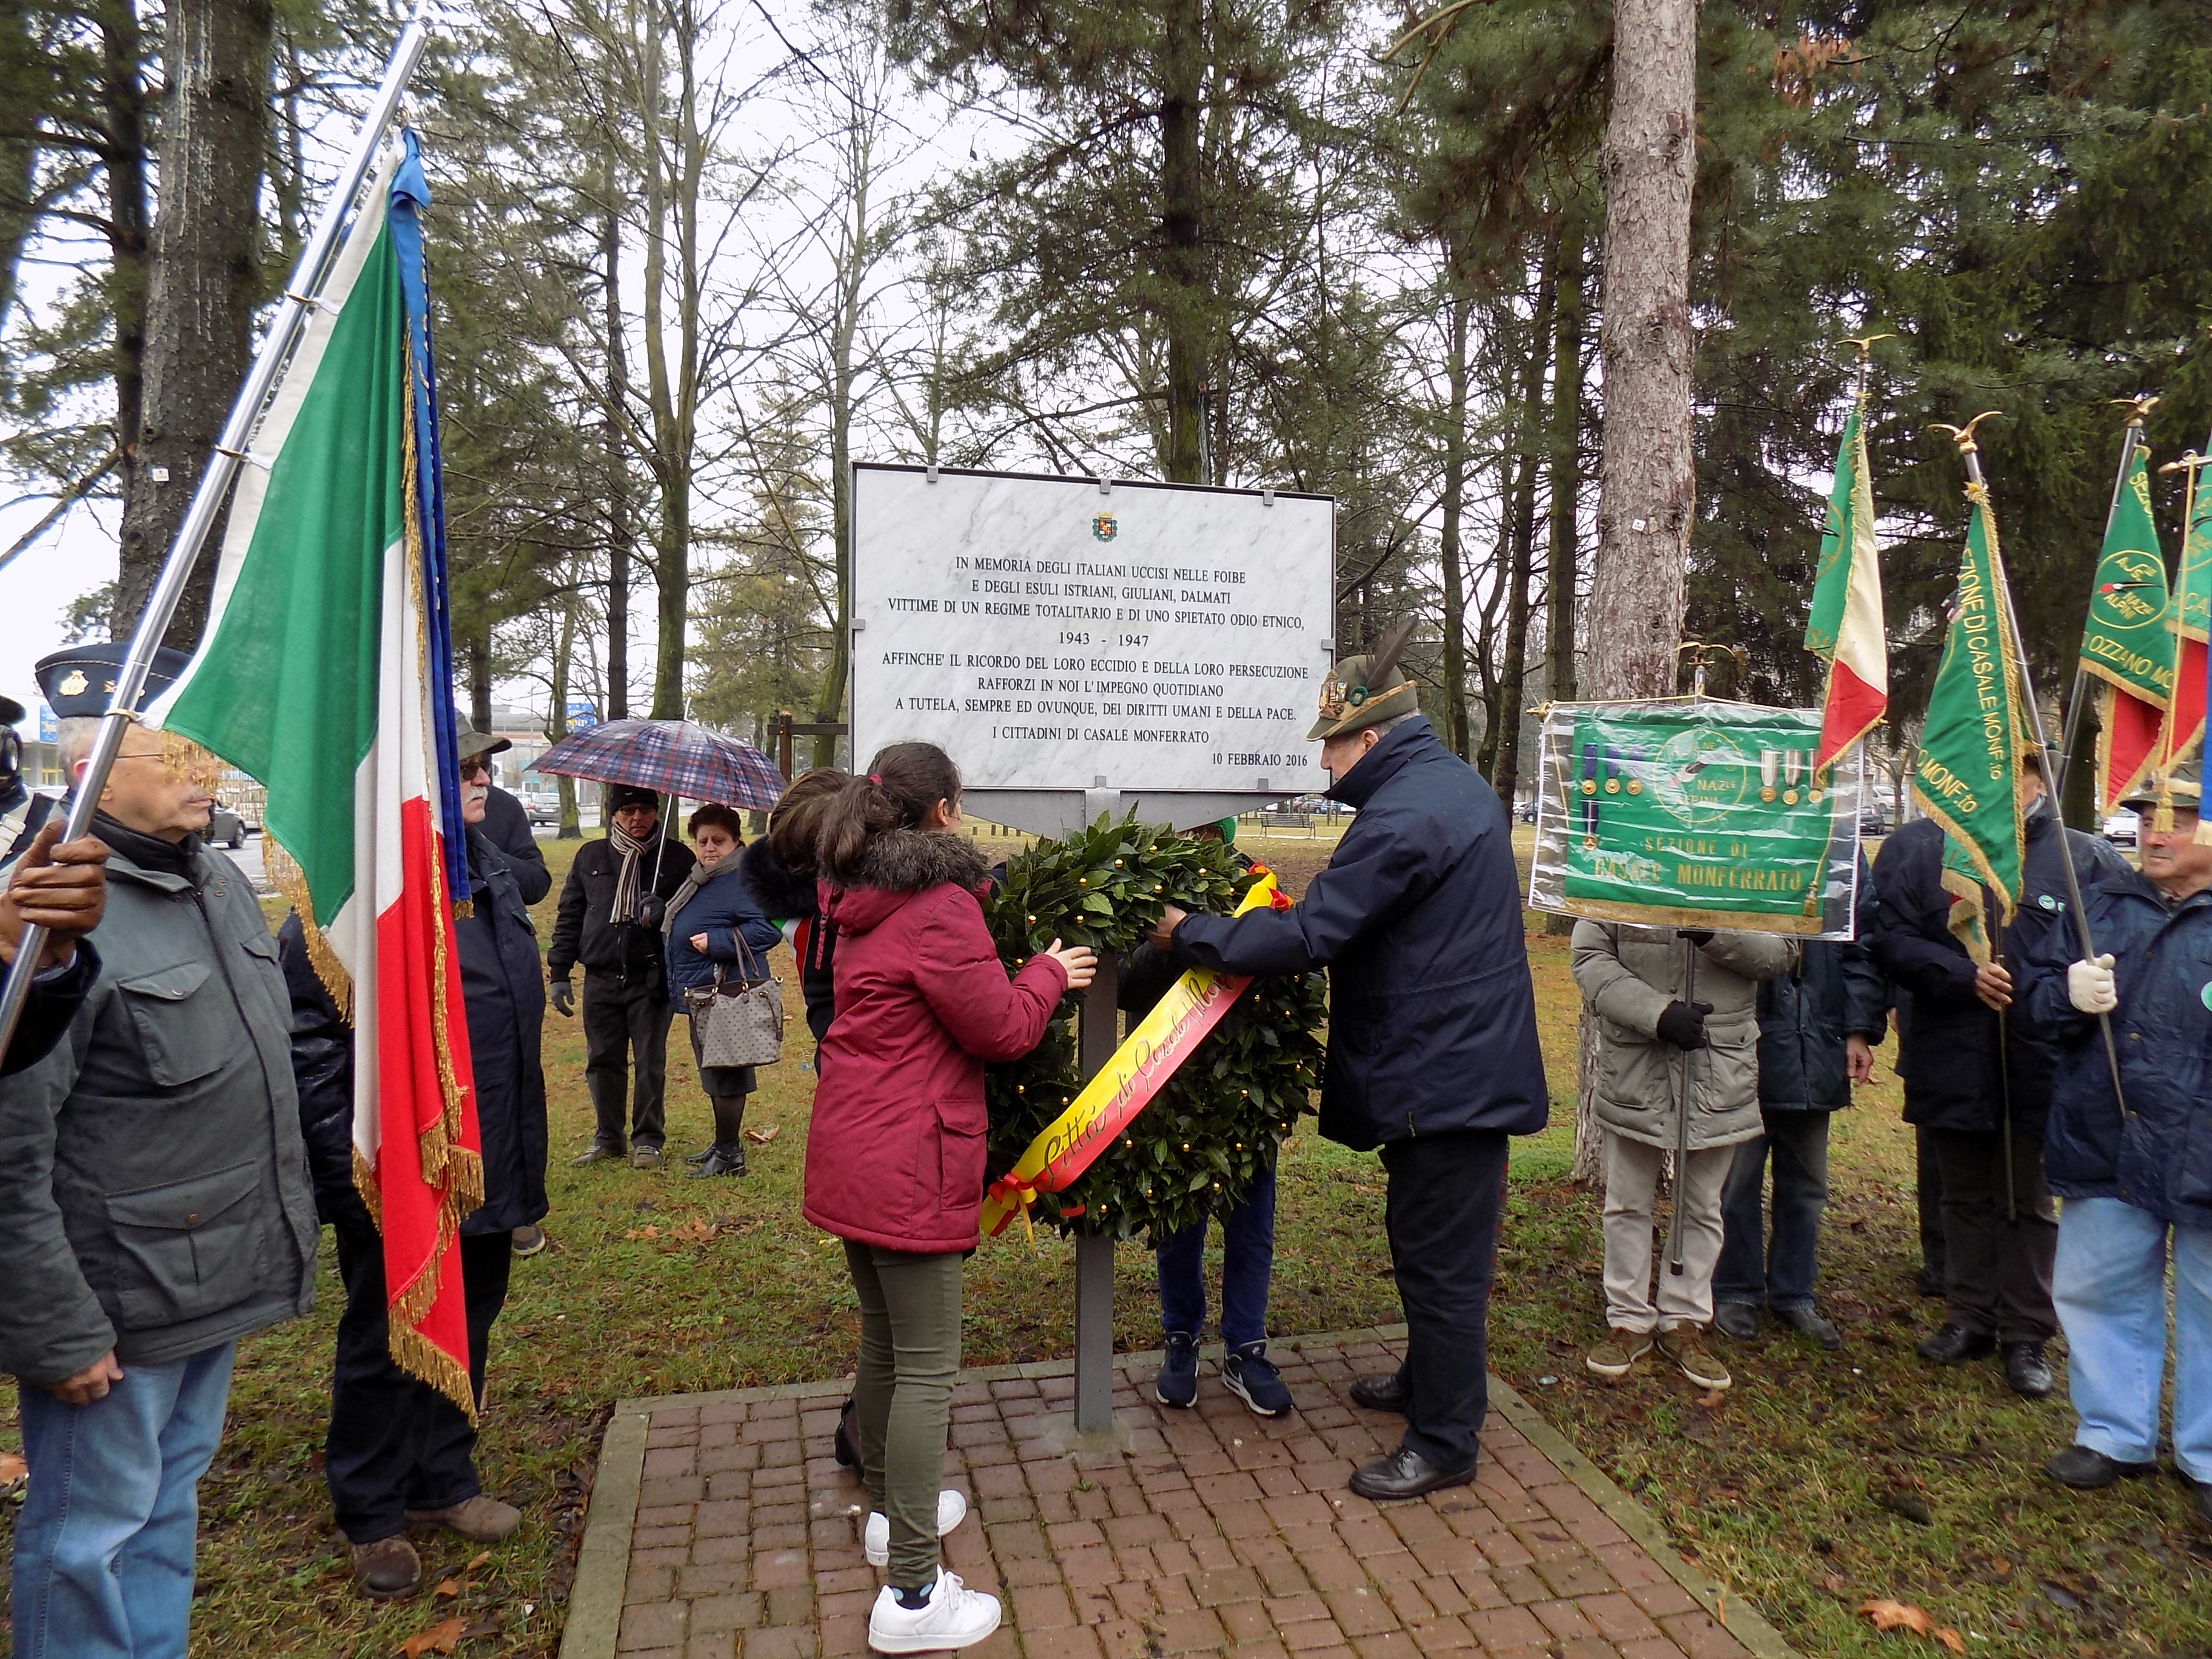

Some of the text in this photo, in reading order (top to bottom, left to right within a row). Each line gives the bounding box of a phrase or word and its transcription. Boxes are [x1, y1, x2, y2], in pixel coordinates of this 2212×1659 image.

[956, 556, 1246, 584] IN MEMORIA DEGLI ITALIANI UCCISI NELLE FOIBE
[971, 579, 1231, 605] E DEGLI ESULI ISTRIANI, GIULIANI, DALMATI
[888, 597, 1304, 631] VITTIME DI UN REGIME TOTALITARIO E DI UNO SPIETATO ODIO ETNICO,
[2103, 593, 2136, 619] ALPINI
[1963, 615, 1988, 634] DI
[1059, 631, 1090, 645] 1943
[1119, 634, 1149, 648] 1947
[882, 652, 1309, 679] AFFINCHE' IL RICORDO DEL LORO ECCIDIO E DELLA LORO PERSECUZIONE
[2089, 635, 2153, 675] OZZANO
[1967, 636, 1997, 711] CASALE
[977, 677, 1224, 698] RAFFORZI IN NOI L'IMPEGNO QUOTIDIANO
[895, 697, 1296, 720] A TUTELA, SEMPRE ED OVUNQUE, DEI DIRITTI UMANI E DELLA PACE.
[993, 726, 1209, 743] I CITTADINI DI CASALE MONFERRATO
[1213, 752, 1308, 766] 10 FEBBRAIO 2016
[1644, 836, 1748, 858] SEZIONE DI
[1595, 857, 1802, 892] CASALE MONFERRATO
[1117, 1071, 1136, 1119] di
[1135, 1012, 1190, 1092] Casale
